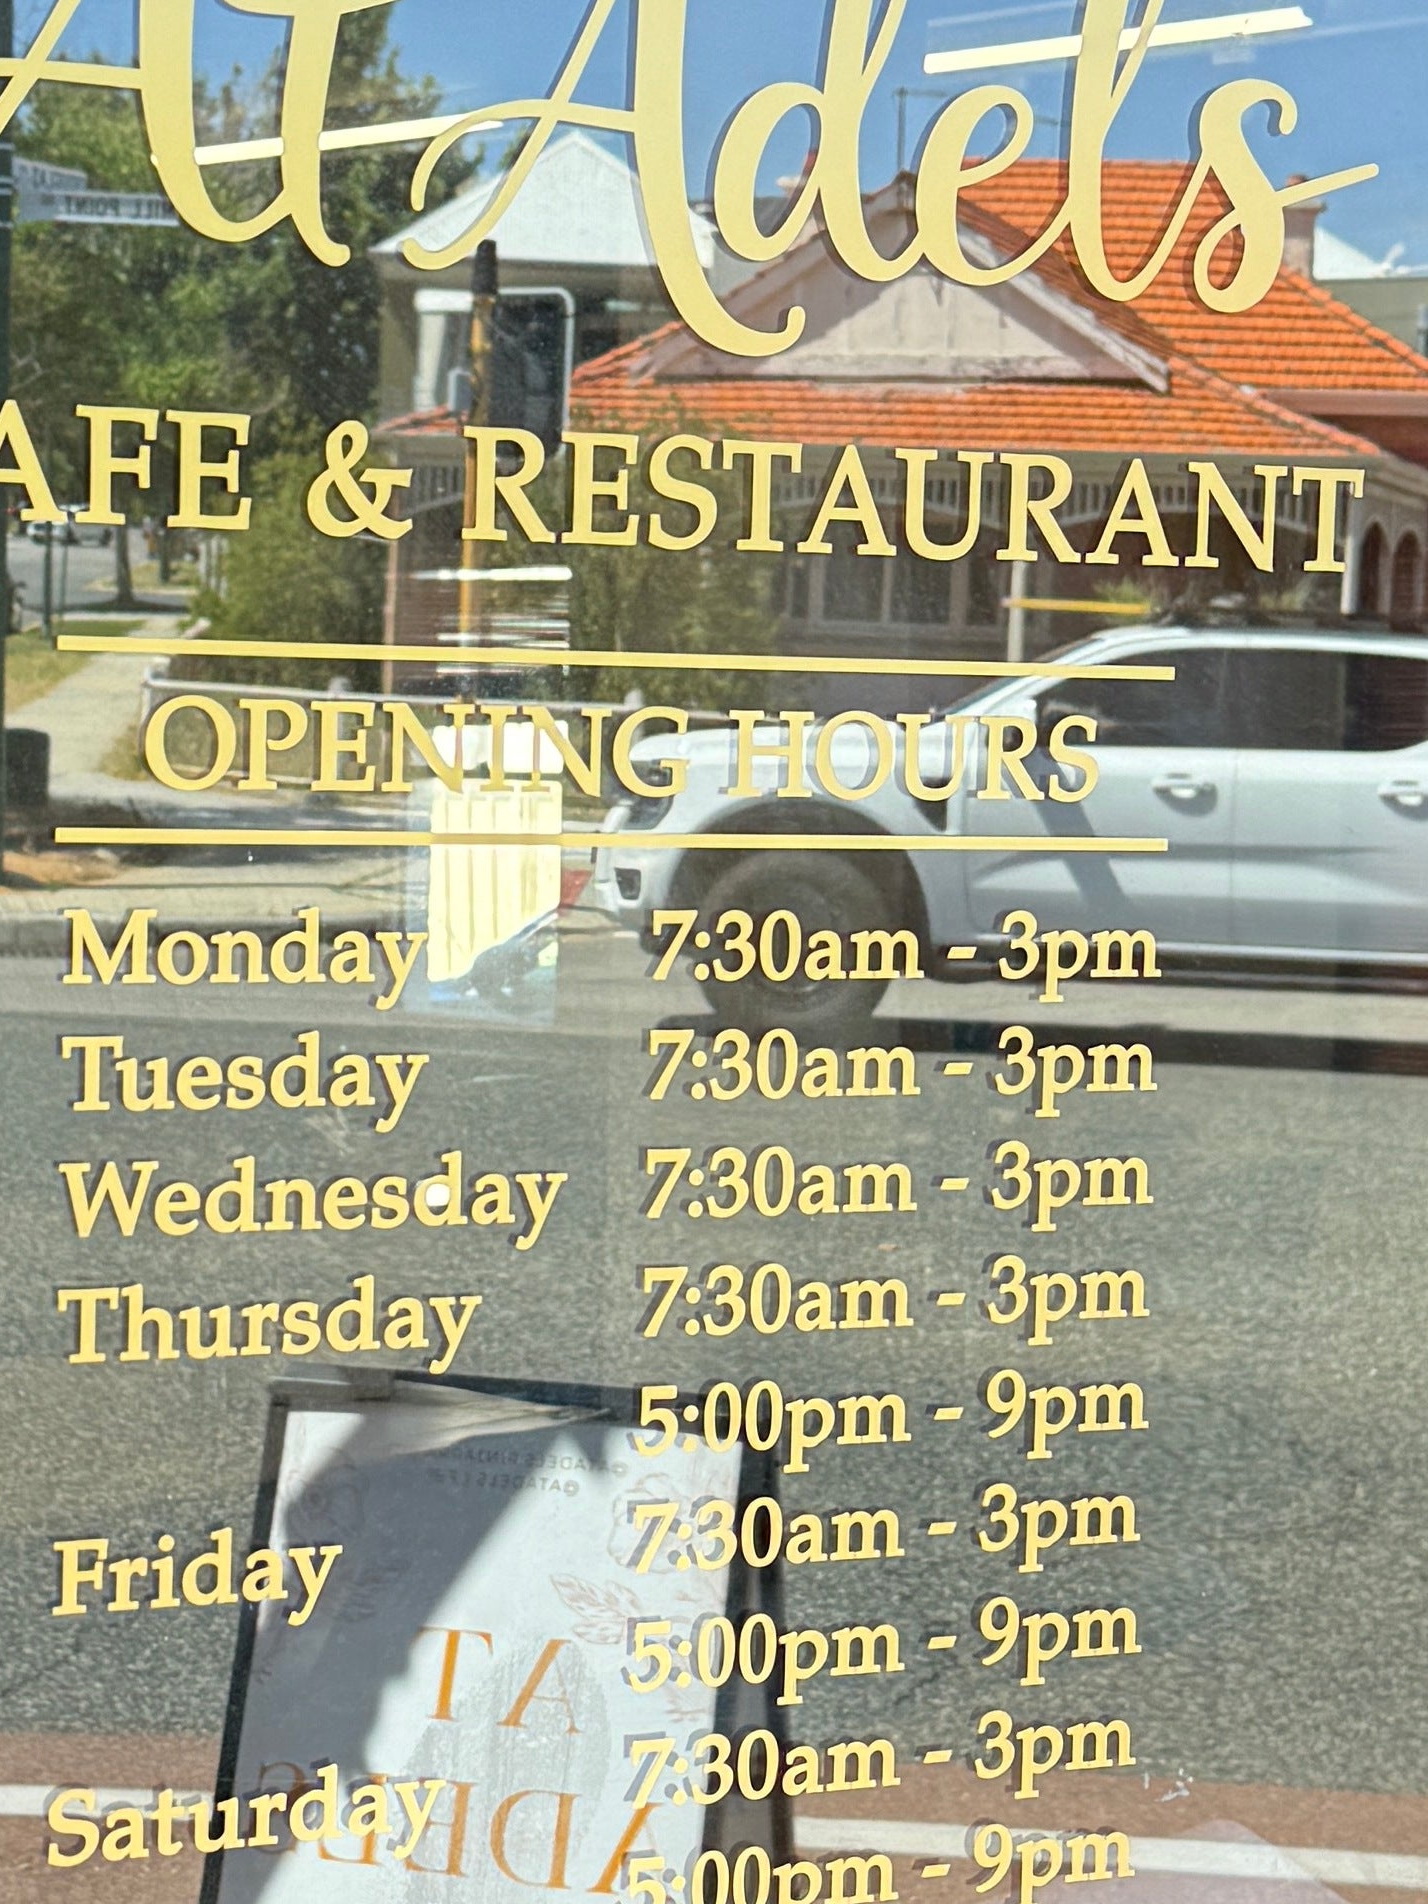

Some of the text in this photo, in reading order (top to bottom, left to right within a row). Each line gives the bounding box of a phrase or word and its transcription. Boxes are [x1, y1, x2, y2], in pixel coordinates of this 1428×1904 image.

[307, 420, 414, 540] &
[460, 422, 1364, 574] RESTAURANT
[143, 696, 1100, 804] OPENING HOURS
[62, 907, 1161, 1010] Monday 7:30am - 3pm
[61, 1025, 1157, 1133] Tuesday 7:30am - 3pm
[59, 1140, 1153, 1250] Wednesday 7:30am - 3pm
[58, 1254, 1150, 1375] Thursday 7:30am - 3pm
[634, 1369, 1149, 1473] 5:00pm - 9pm
[52, 1528, 343, 1626] Friday
[633, 1483, 1141, 1574] 7:30am - 3pm
[628, 1596, 1142, 1705] 5:00pm - 9pm
[629, 1710, 1136, 1810] 7:30am - 3pm
[47, 1763, 447, 1868] Saturday
[921, 1863, 951, 1878] -
